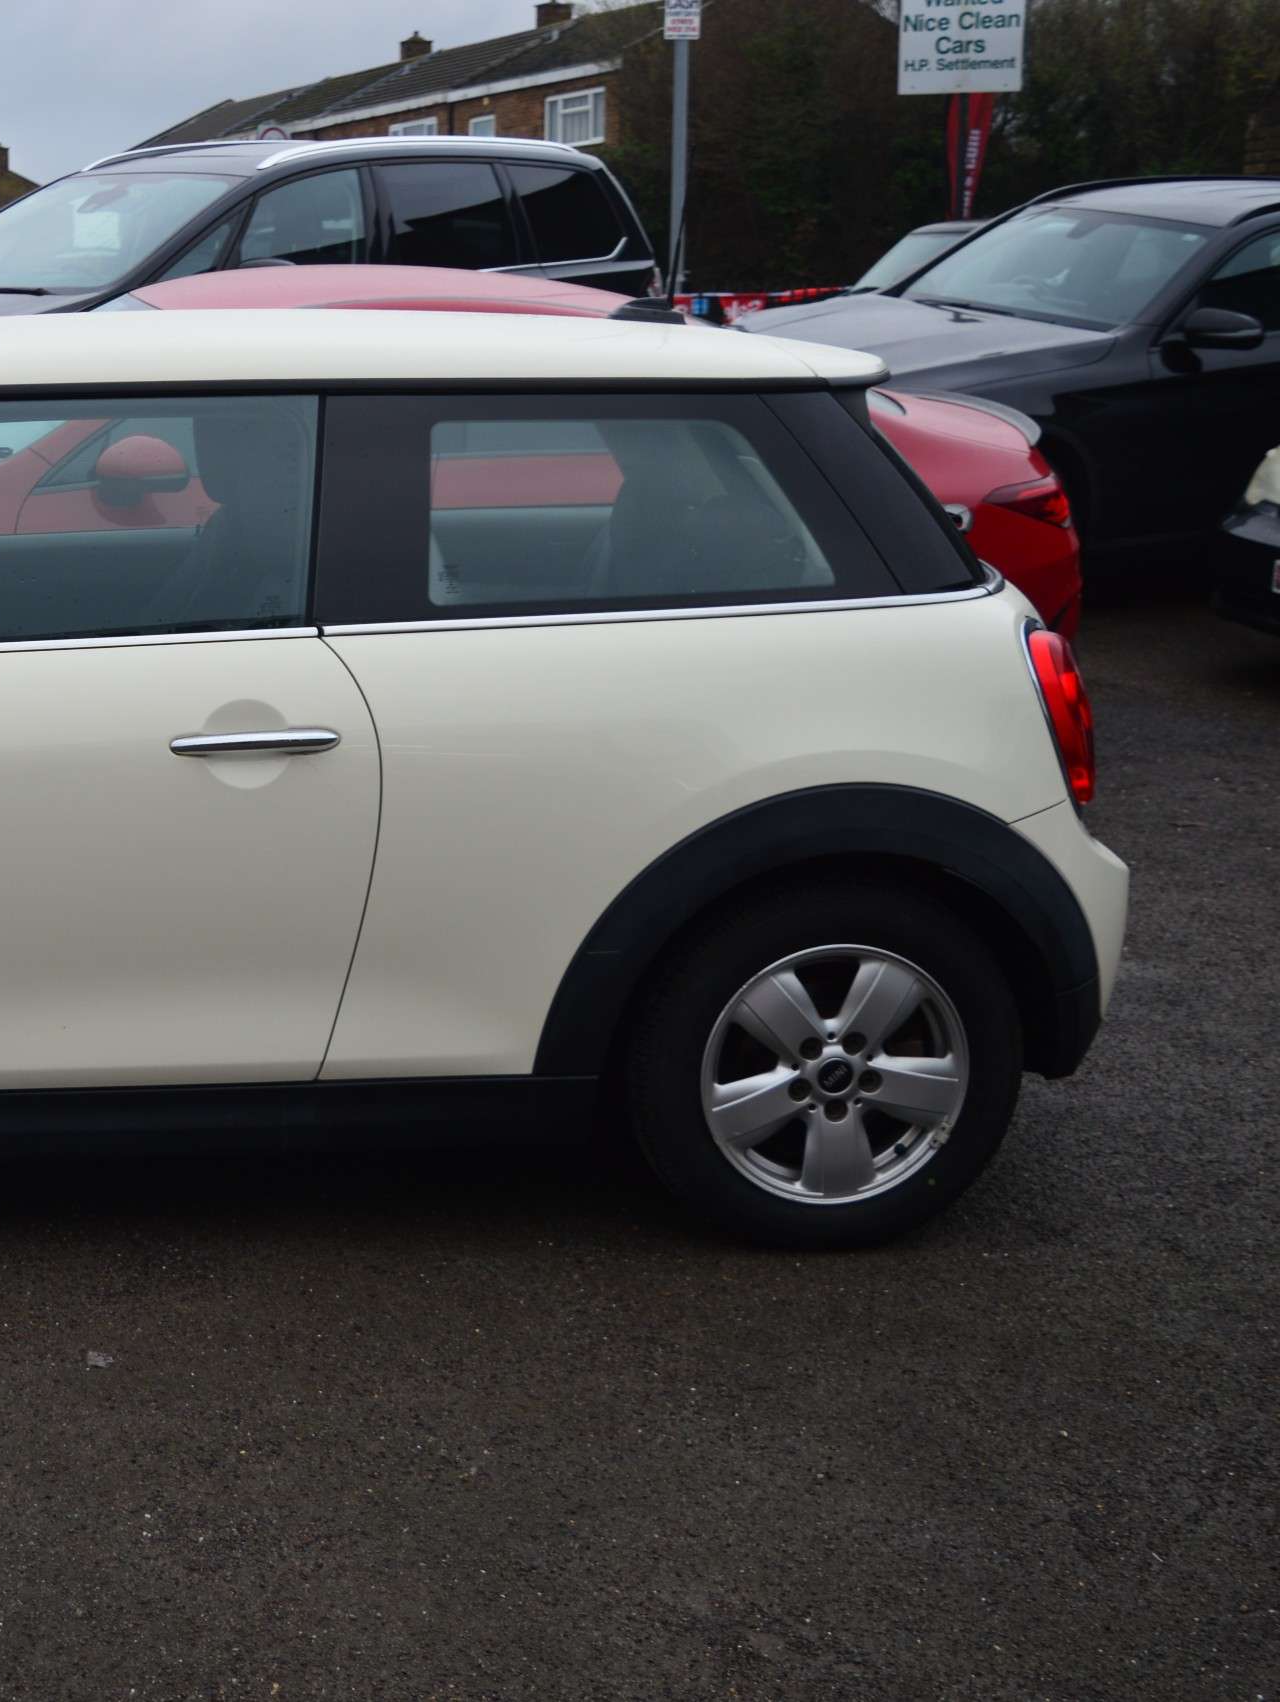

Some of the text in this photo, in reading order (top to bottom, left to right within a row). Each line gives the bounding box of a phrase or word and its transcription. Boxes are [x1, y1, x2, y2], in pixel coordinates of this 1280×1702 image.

[903, 11, 1021, 32] Nice Clean
[935, 36, 986, 54] Cars
[936, 57, 1017, 71] Settlement
